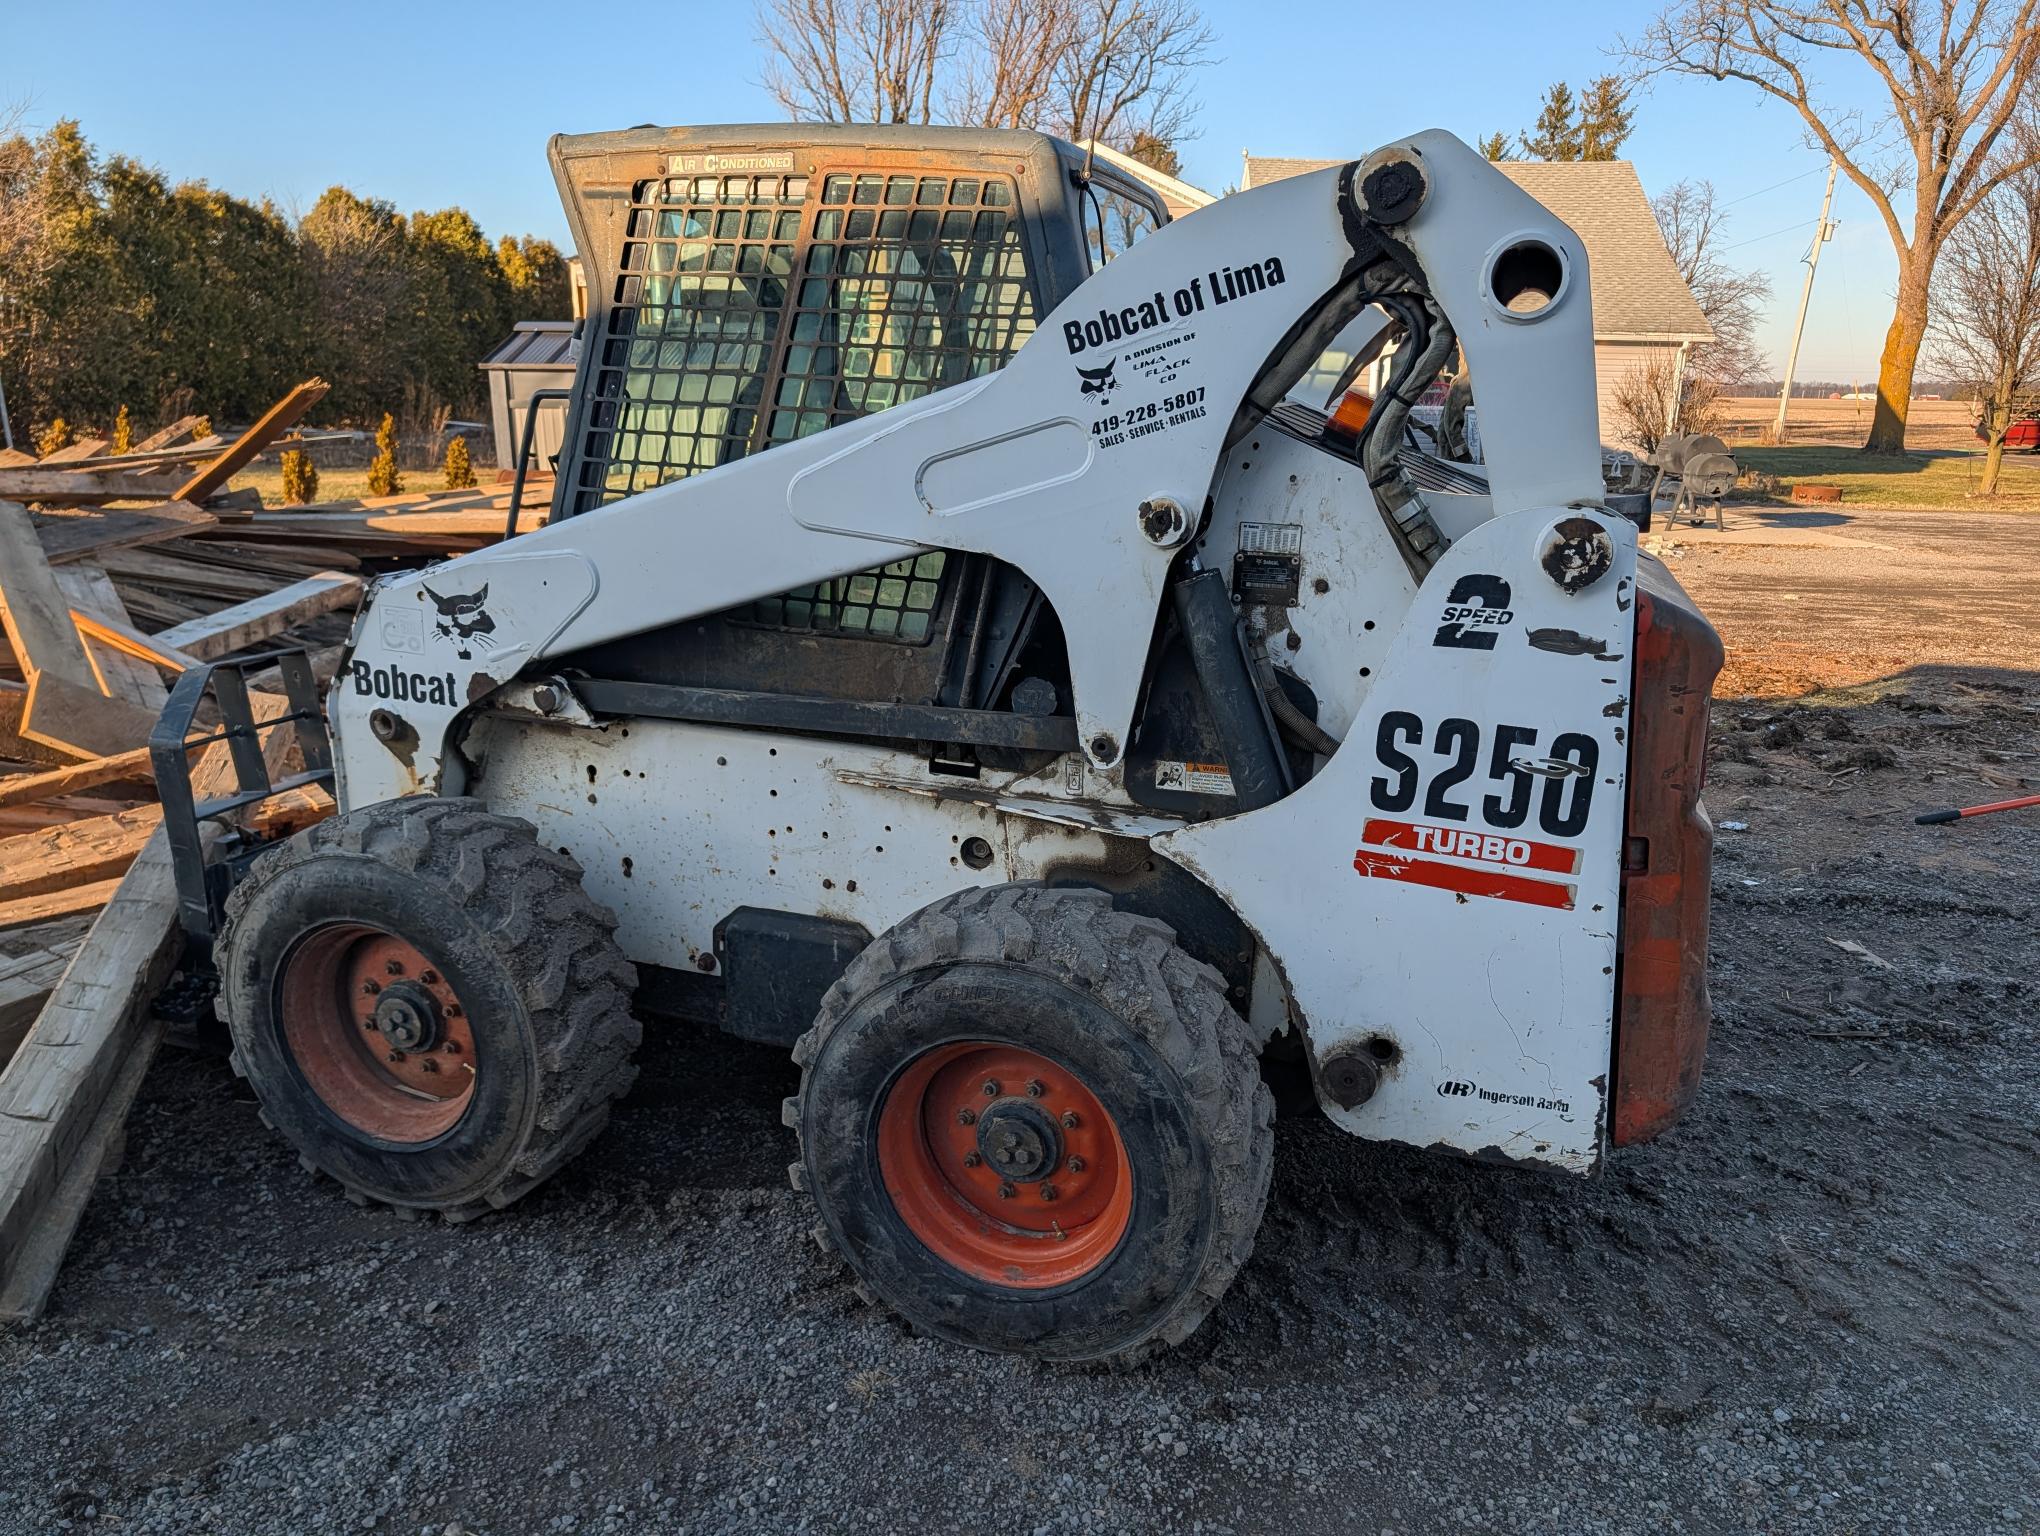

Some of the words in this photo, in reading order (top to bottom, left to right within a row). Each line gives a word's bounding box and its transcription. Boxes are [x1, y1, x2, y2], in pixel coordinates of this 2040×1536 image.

[703, 155, 791, 172] CONDITIONED
[1063, 292, 1170, 355] Bobcat
[1173, 277, 1205, 317] of
[1208, 256, 1286, 306] Lima
[1124, 354, 1131, 362] A
[1133, 337, 1181, 359] DIVISION
[1183, 332, 1197, 342] OF
[1133, 355, 1167, 370] LIMA
[1145, 357, 1192, 378] FLACK
[1160, 373, 1177, 384] CO
[1091, 386, 1205, 435] 419-228-5807
[1099, 432, 1125, 449] SALES
[1129, 419, 1165, 442] SERVICE
[1169, 405, 1206, 427] RENTALS
[1441, 606, 1514, 625] SPEED
[352, 660, 458, 707] Bobcat
[1370, 710, 1600, 837] S250
[1413, 825, 1531, 865] TURBO
[1479, 1087, 1534, 1107] Ingersoll
